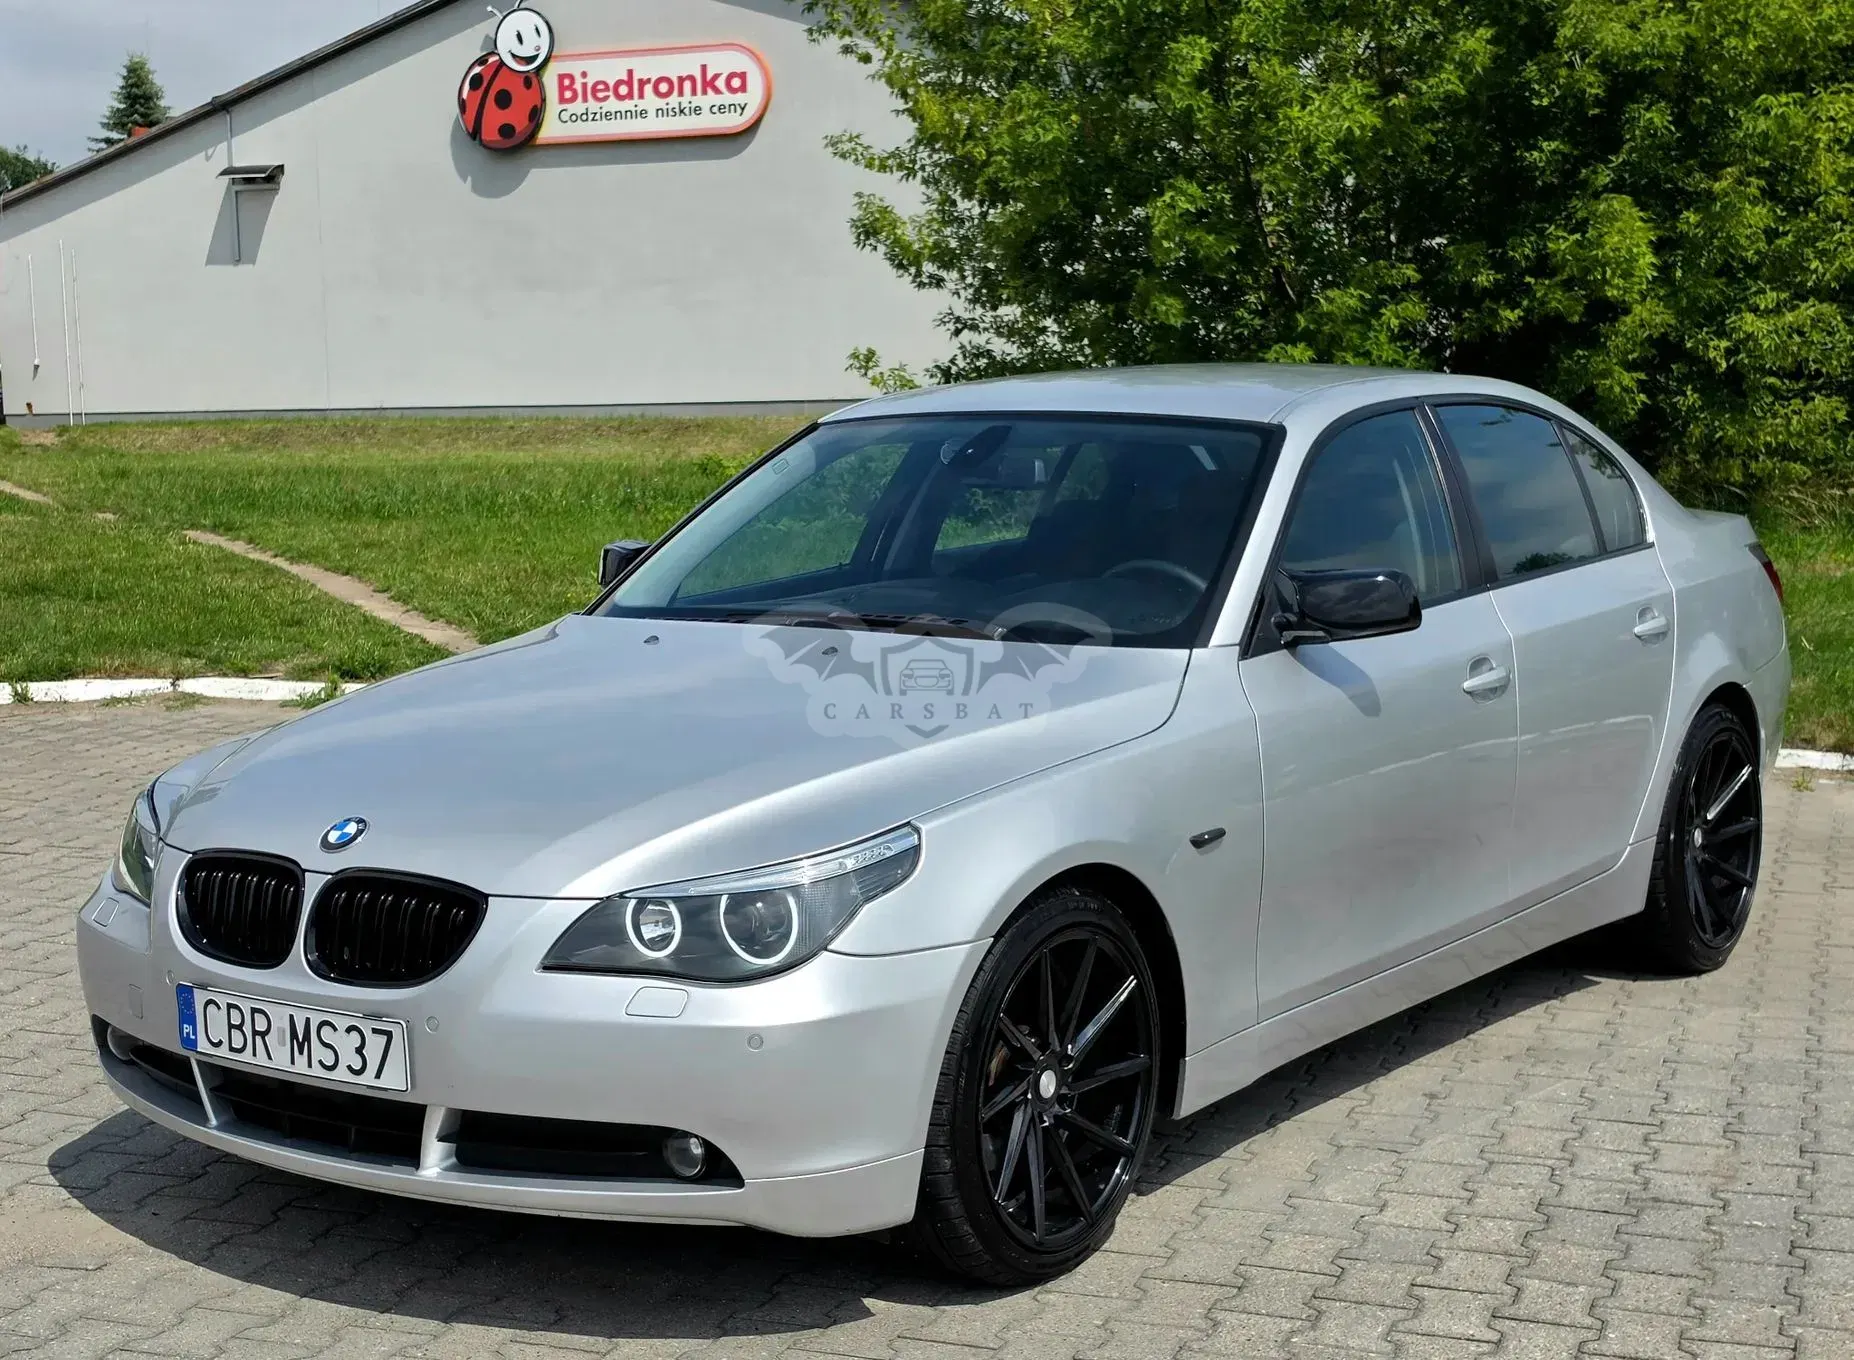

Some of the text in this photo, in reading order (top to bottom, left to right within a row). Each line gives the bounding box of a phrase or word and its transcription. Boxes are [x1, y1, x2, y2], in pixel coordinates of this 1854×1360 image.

[557, 64, 748, 105] Biedronka
[558, 101, 748, 123] Codziennie niskie ceny
[183, 1024, 195, 1039] PL
[203, 998, 394, 1080] CBR MS37
